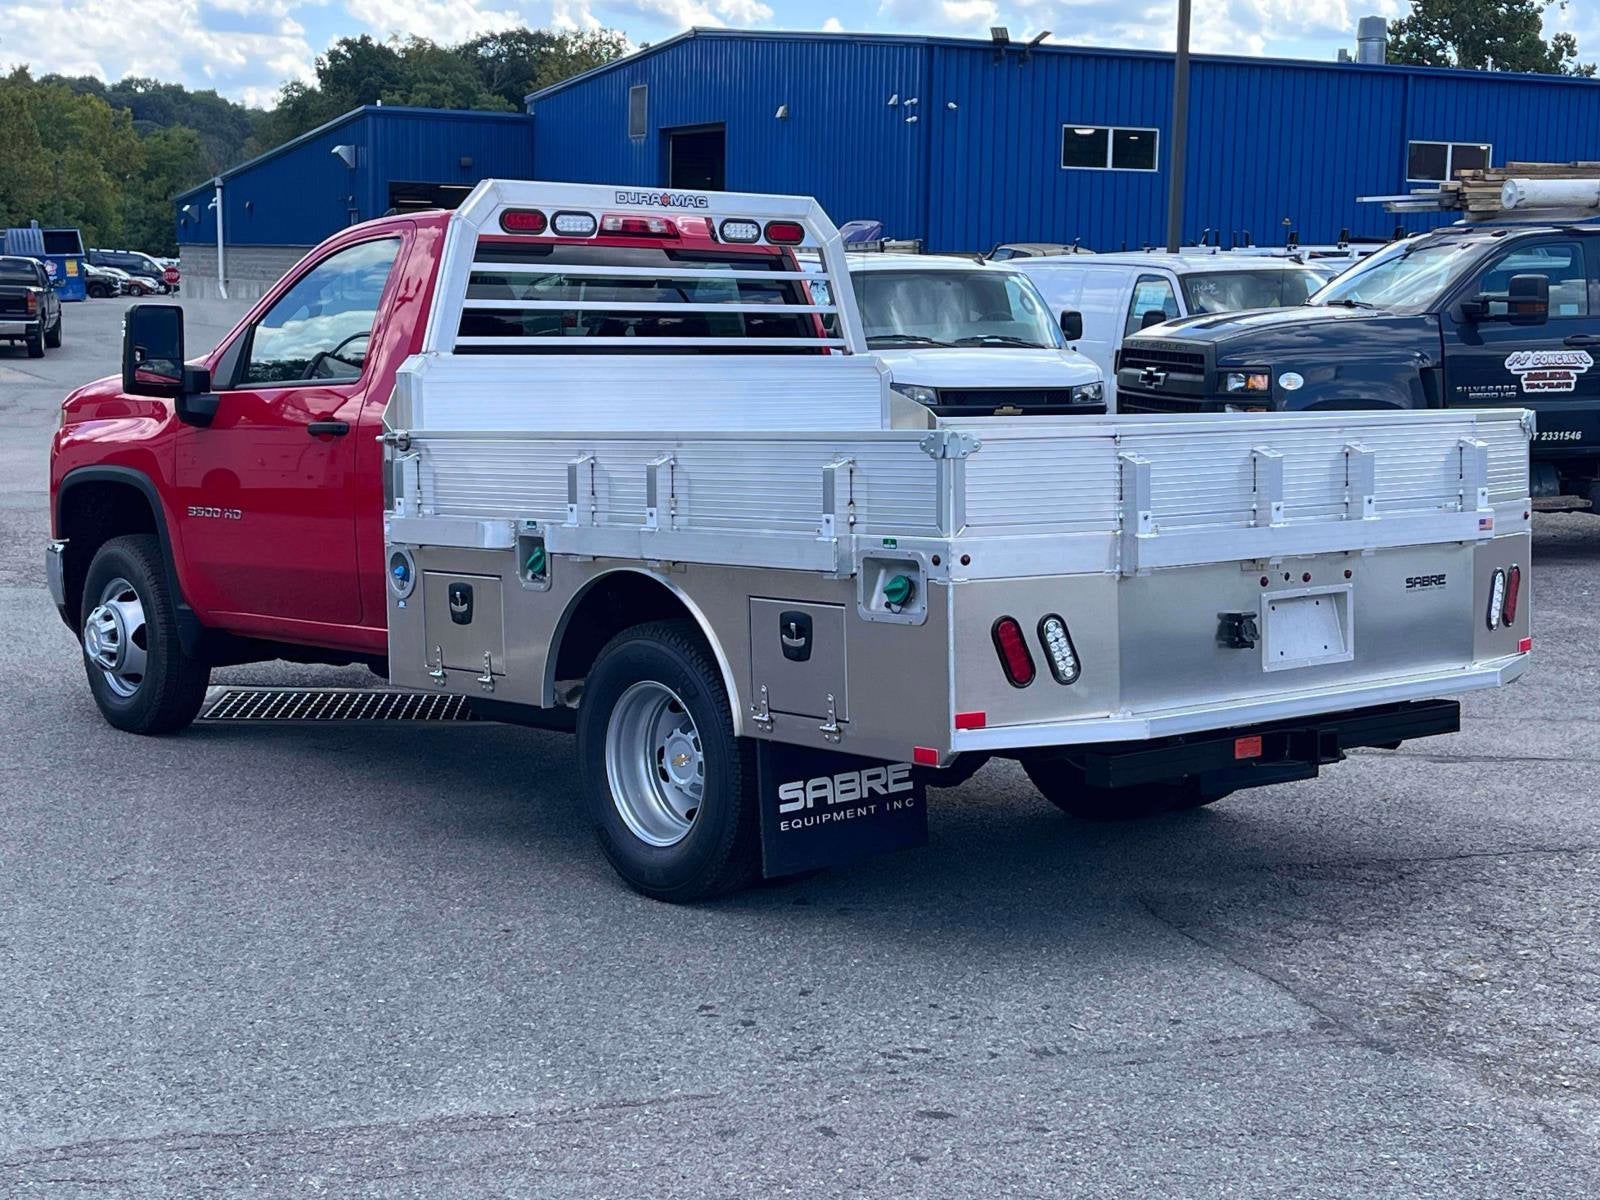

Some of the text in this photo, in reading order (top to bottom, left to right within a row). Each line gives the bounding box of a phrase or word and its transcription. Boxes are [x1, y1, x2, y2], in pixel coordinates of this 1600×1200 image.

[165, 271, 179, 280] STOP
[1532, 352, 1592, 365] CONCRETE
[1541, 431, 1582, 440] 2331546
[187, 506, 242, 520] 3500 HD
[1405, 574, 1447, 588] SABRE
[778, 762, 914, 814] SABRE
[780, 798, 915, 831] EQUIPMENT INC
